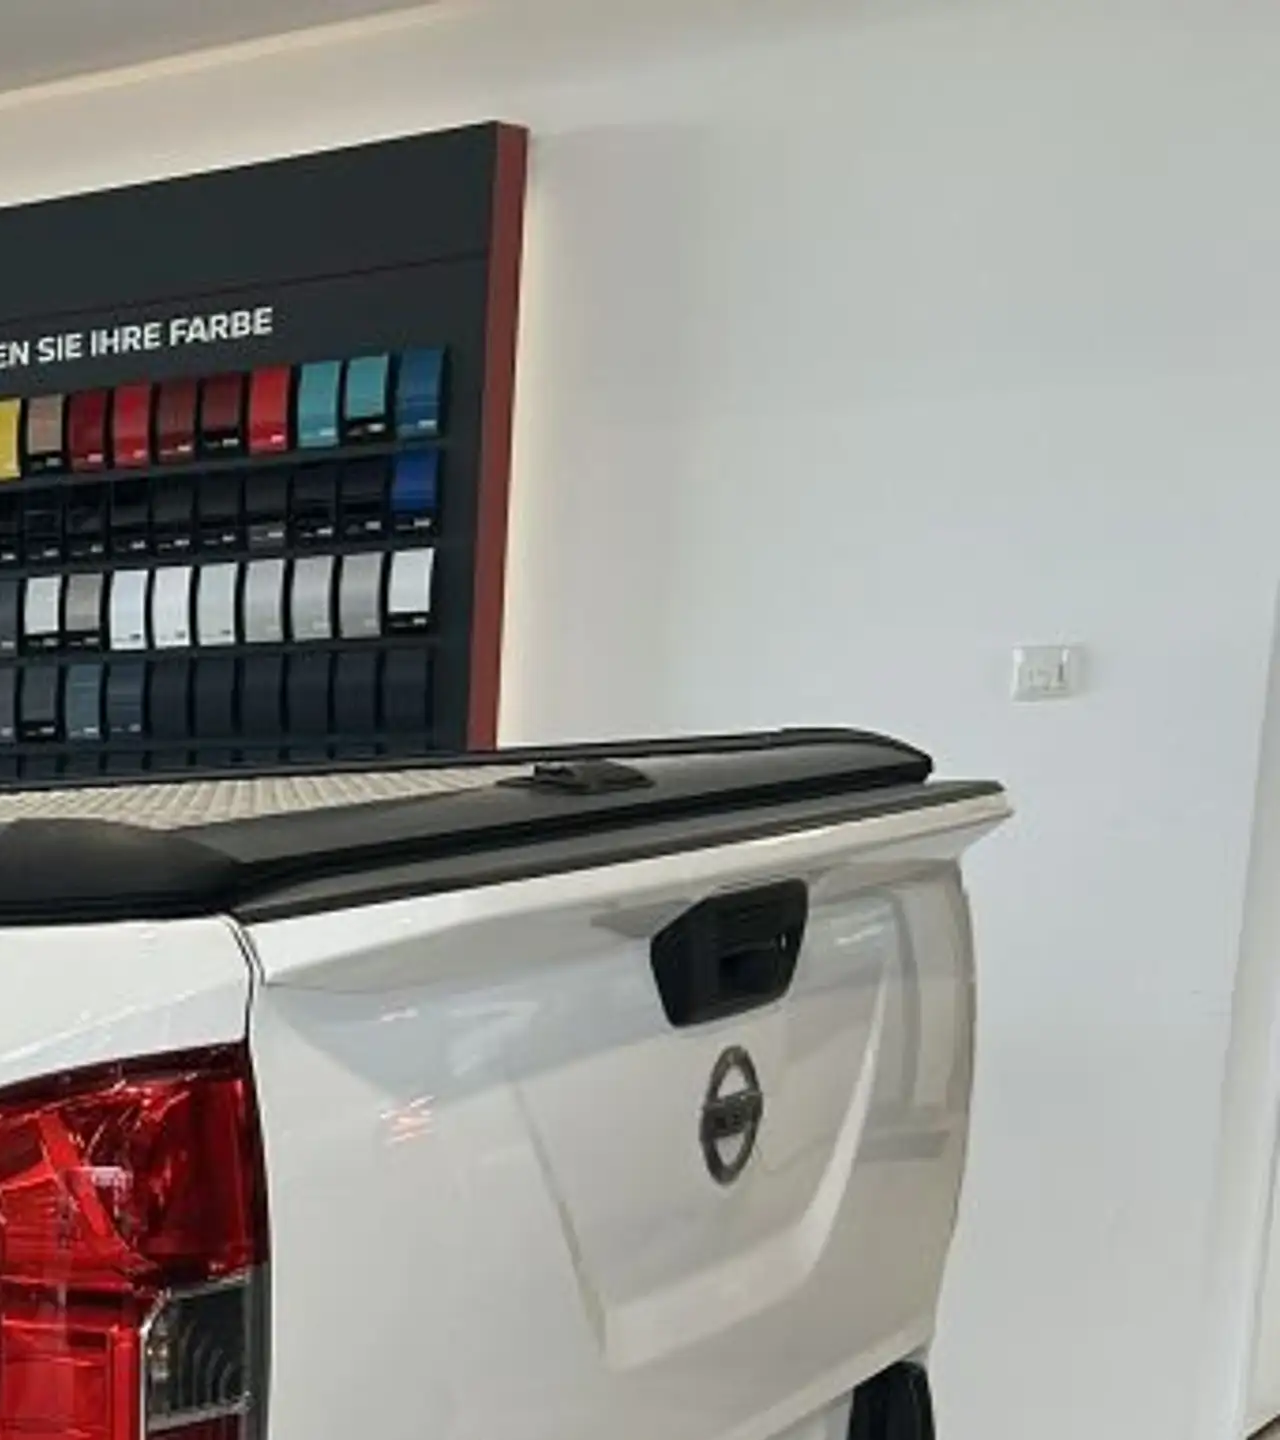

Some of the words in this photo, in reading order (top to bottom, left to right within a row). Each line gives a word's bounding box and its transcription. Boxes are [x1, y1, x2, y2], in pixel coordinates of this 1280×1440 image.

[36, 332, 83, 363] SIE
[90, 321, 162, 357] IHRE
[169, 306, 274, 347] FARBE
